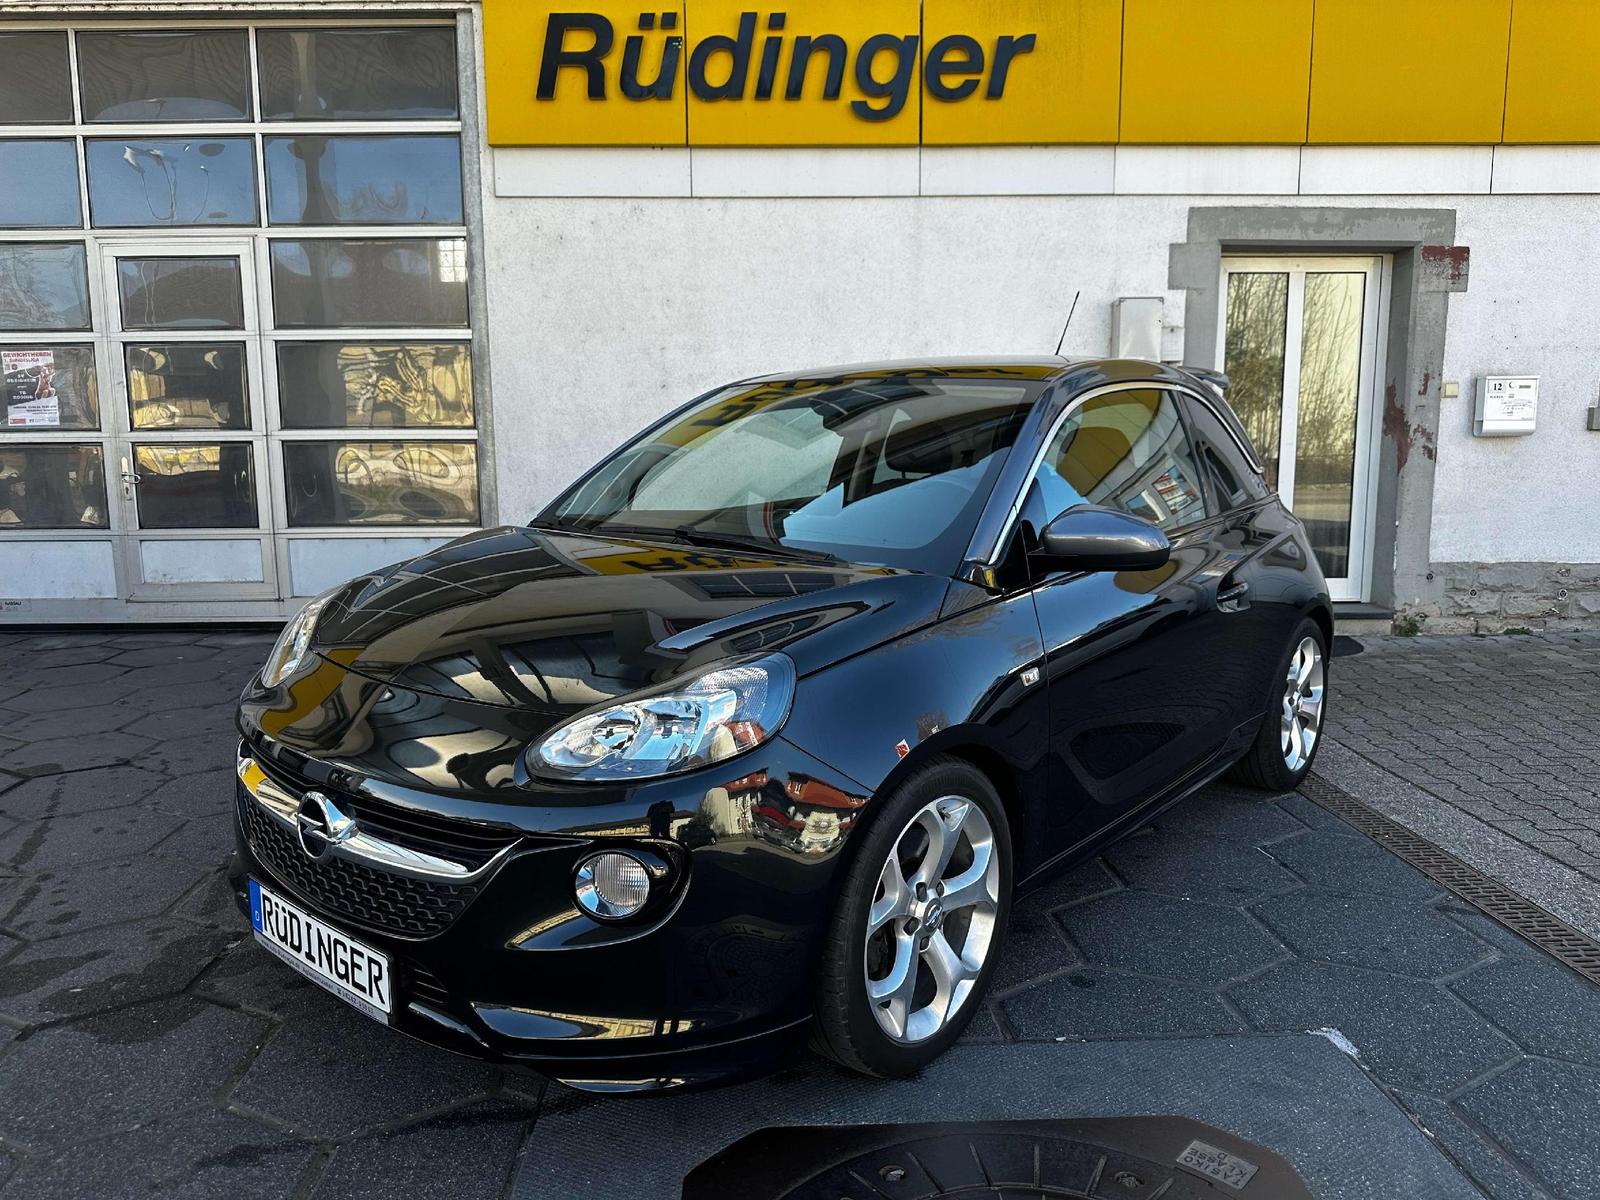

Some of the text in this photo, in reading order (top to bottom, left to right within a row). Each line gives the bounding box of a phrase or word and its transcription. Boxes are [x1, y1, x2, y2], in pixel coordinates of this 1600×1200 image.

[535, 11, 1038, 122] Rüdinger
[1493, 382, 1503, 391] 12
[1187, 1147, 1248, 1178] KLASSE
[1217, 1152, 1228, 1160] D
